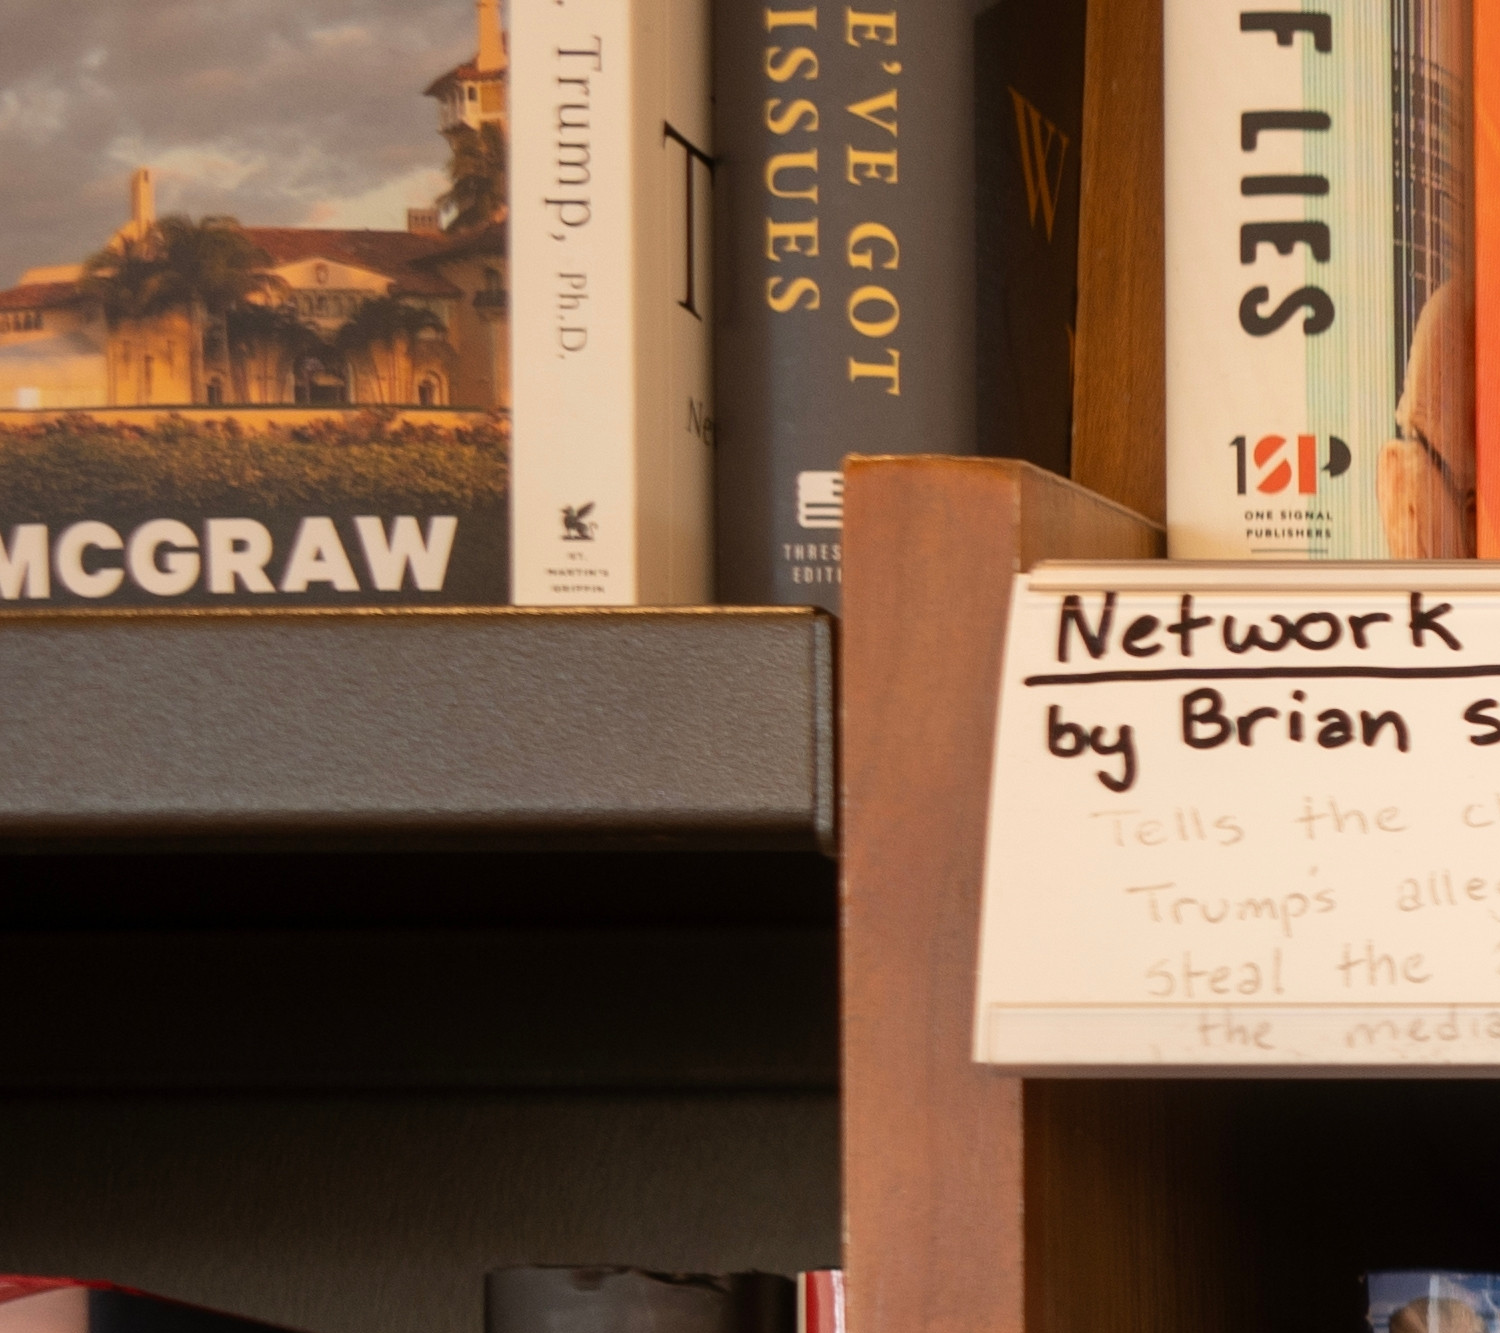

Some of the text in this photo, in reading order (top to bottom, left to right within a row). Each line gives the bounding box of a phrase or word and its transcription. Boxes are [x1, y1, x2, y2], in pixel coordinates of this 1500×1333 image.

[546, 36, 602, 243] Trump,
[766, 8, 819, 313] ISSUES
[1238, 110, 1335, 337] LIES
[848, 221, 901, 396] GOT
[1244, 510, 1334, 522] ONE SIGNAL
[1246, 528, 1332, 539] PUBLISHERS
[0, 516, 458, 601] MCGRAW
[1056, 592, 1463, 663] Network
[1046, 703, 1138, 793] by
[1180, 687, 1411, 753] Brian
[1090, 806, 1246, 848] Tells
[1294, 795, 1409, 840] the
[1145, 948, 1287, 998] steal
[1333, 941, 1434, 987] the
[1198, 1007, 1275, 1050] the
